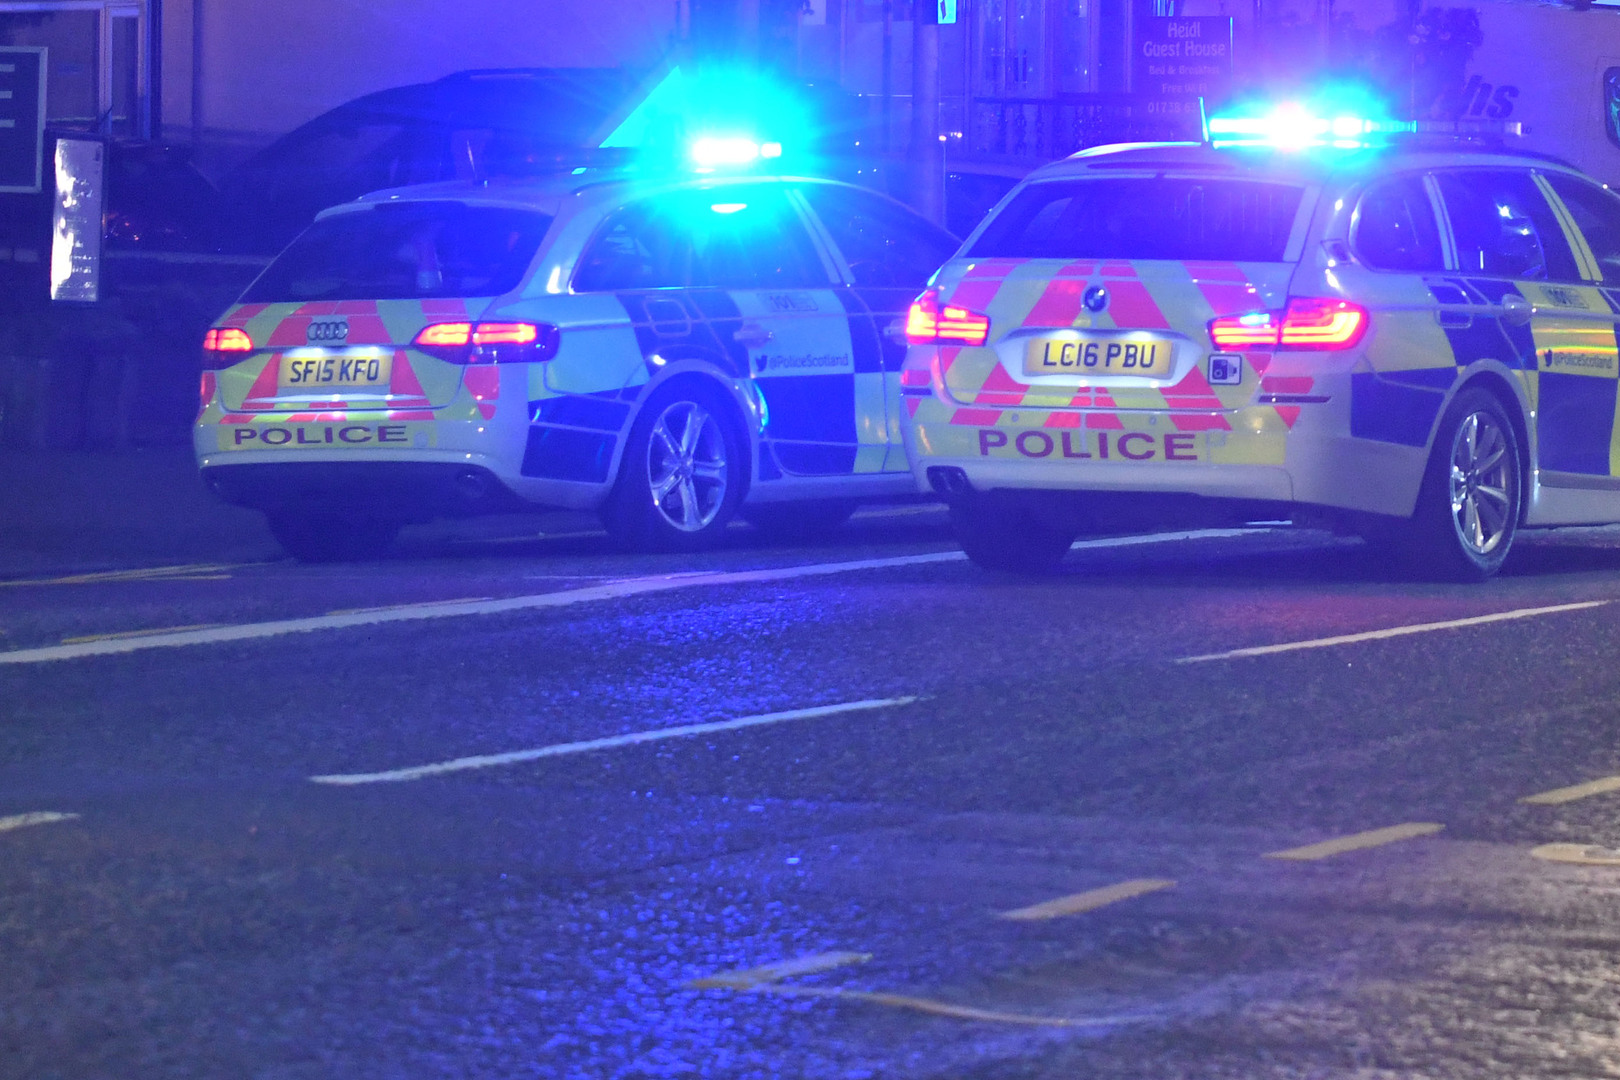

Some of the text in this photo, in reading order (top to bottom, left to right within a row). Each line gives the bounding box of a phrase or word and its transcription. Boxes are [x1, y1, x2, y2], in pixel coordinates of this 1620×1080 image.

[1143, 41, 1226, 57] Guest House
[1162, 83, 1182, 94] Free
[769, 353, 849, 370] @PoliceScotland
[1043, 342, 1156, 368] LC16 PBU
[1553, 351, 1613, 369] @PoliceScotland
[290, 359, 380, 383] SF15 KFO
[234, 424, 409, 445] POLICE
[978, 429, 1198, 461] POLICE
